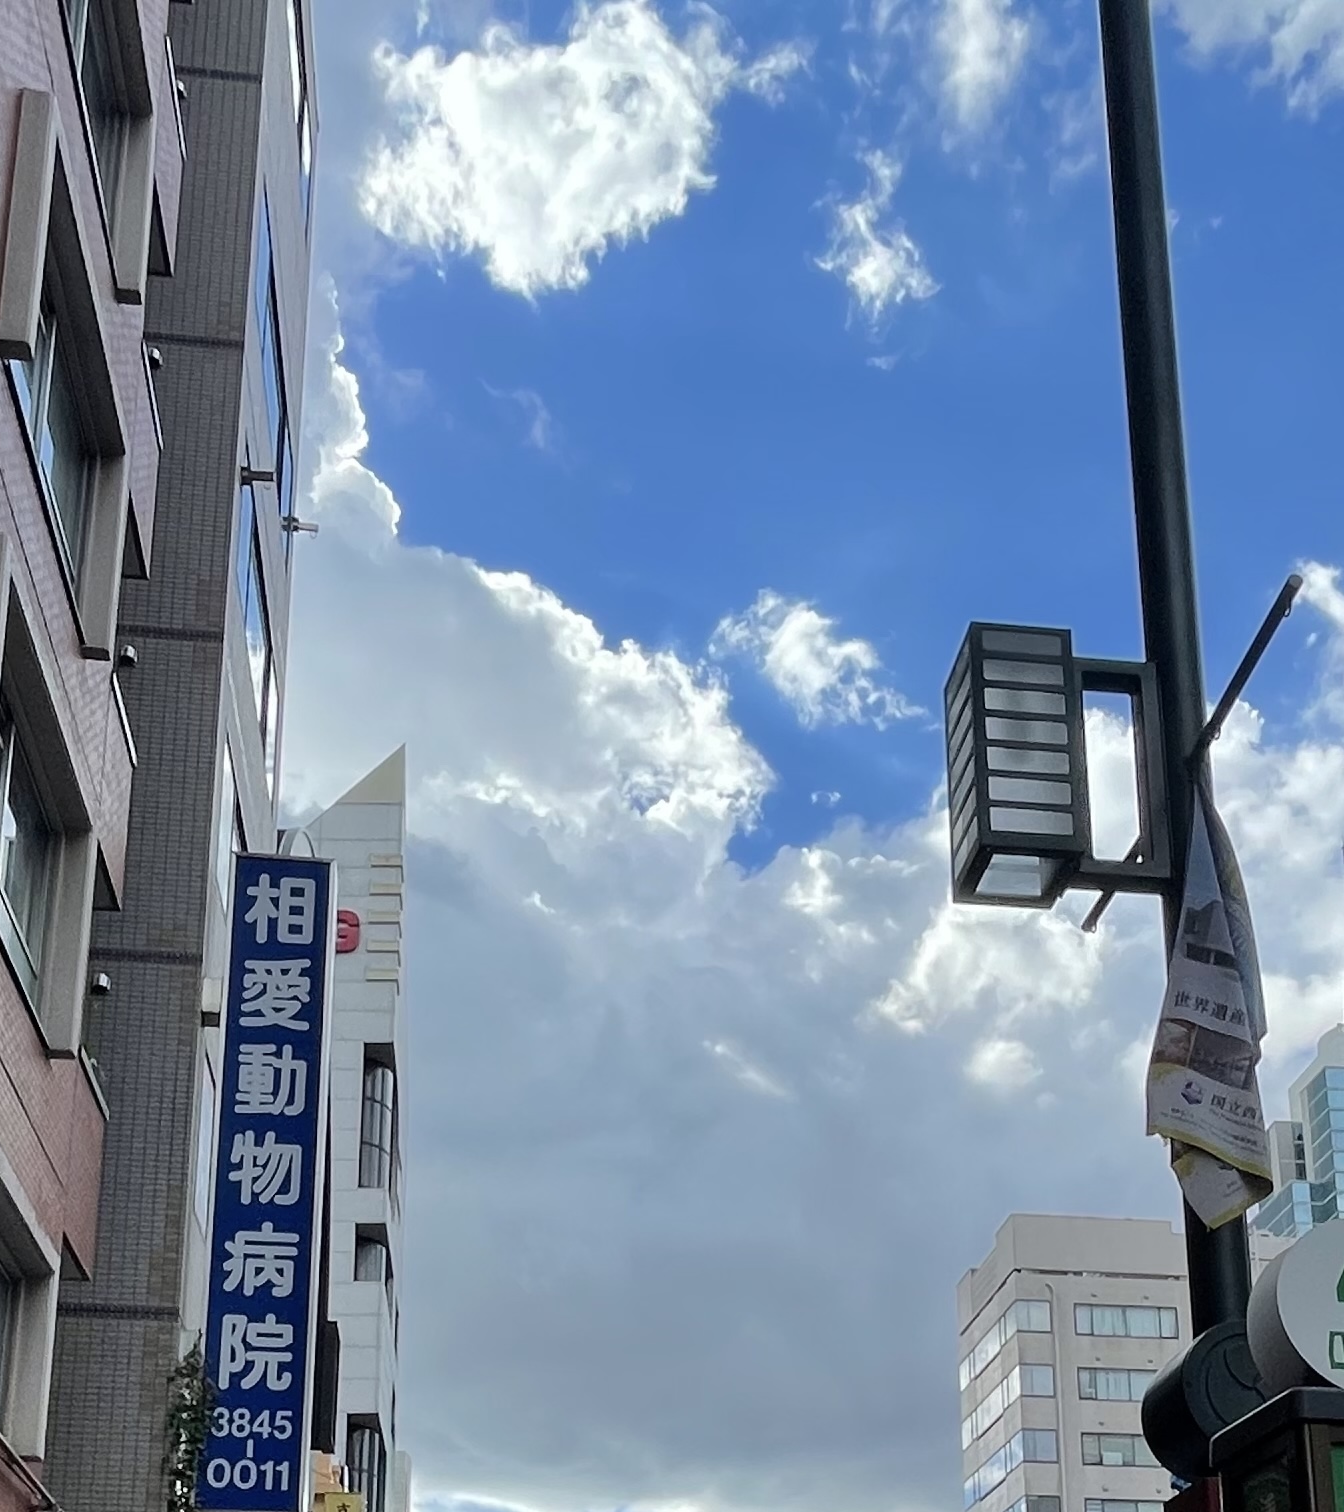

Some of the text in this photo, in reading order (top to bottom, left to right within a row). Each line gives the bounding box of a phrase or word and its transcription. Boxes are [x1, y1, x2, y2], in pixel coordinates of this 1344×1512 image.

[1173, 990, 1247, 1027] 世界遺産
[218, 872, 317, 1392] 相愛動物病院
[211, 1407, 293, 1440] 3845
[206, 1458, 289, 1491] 0011
